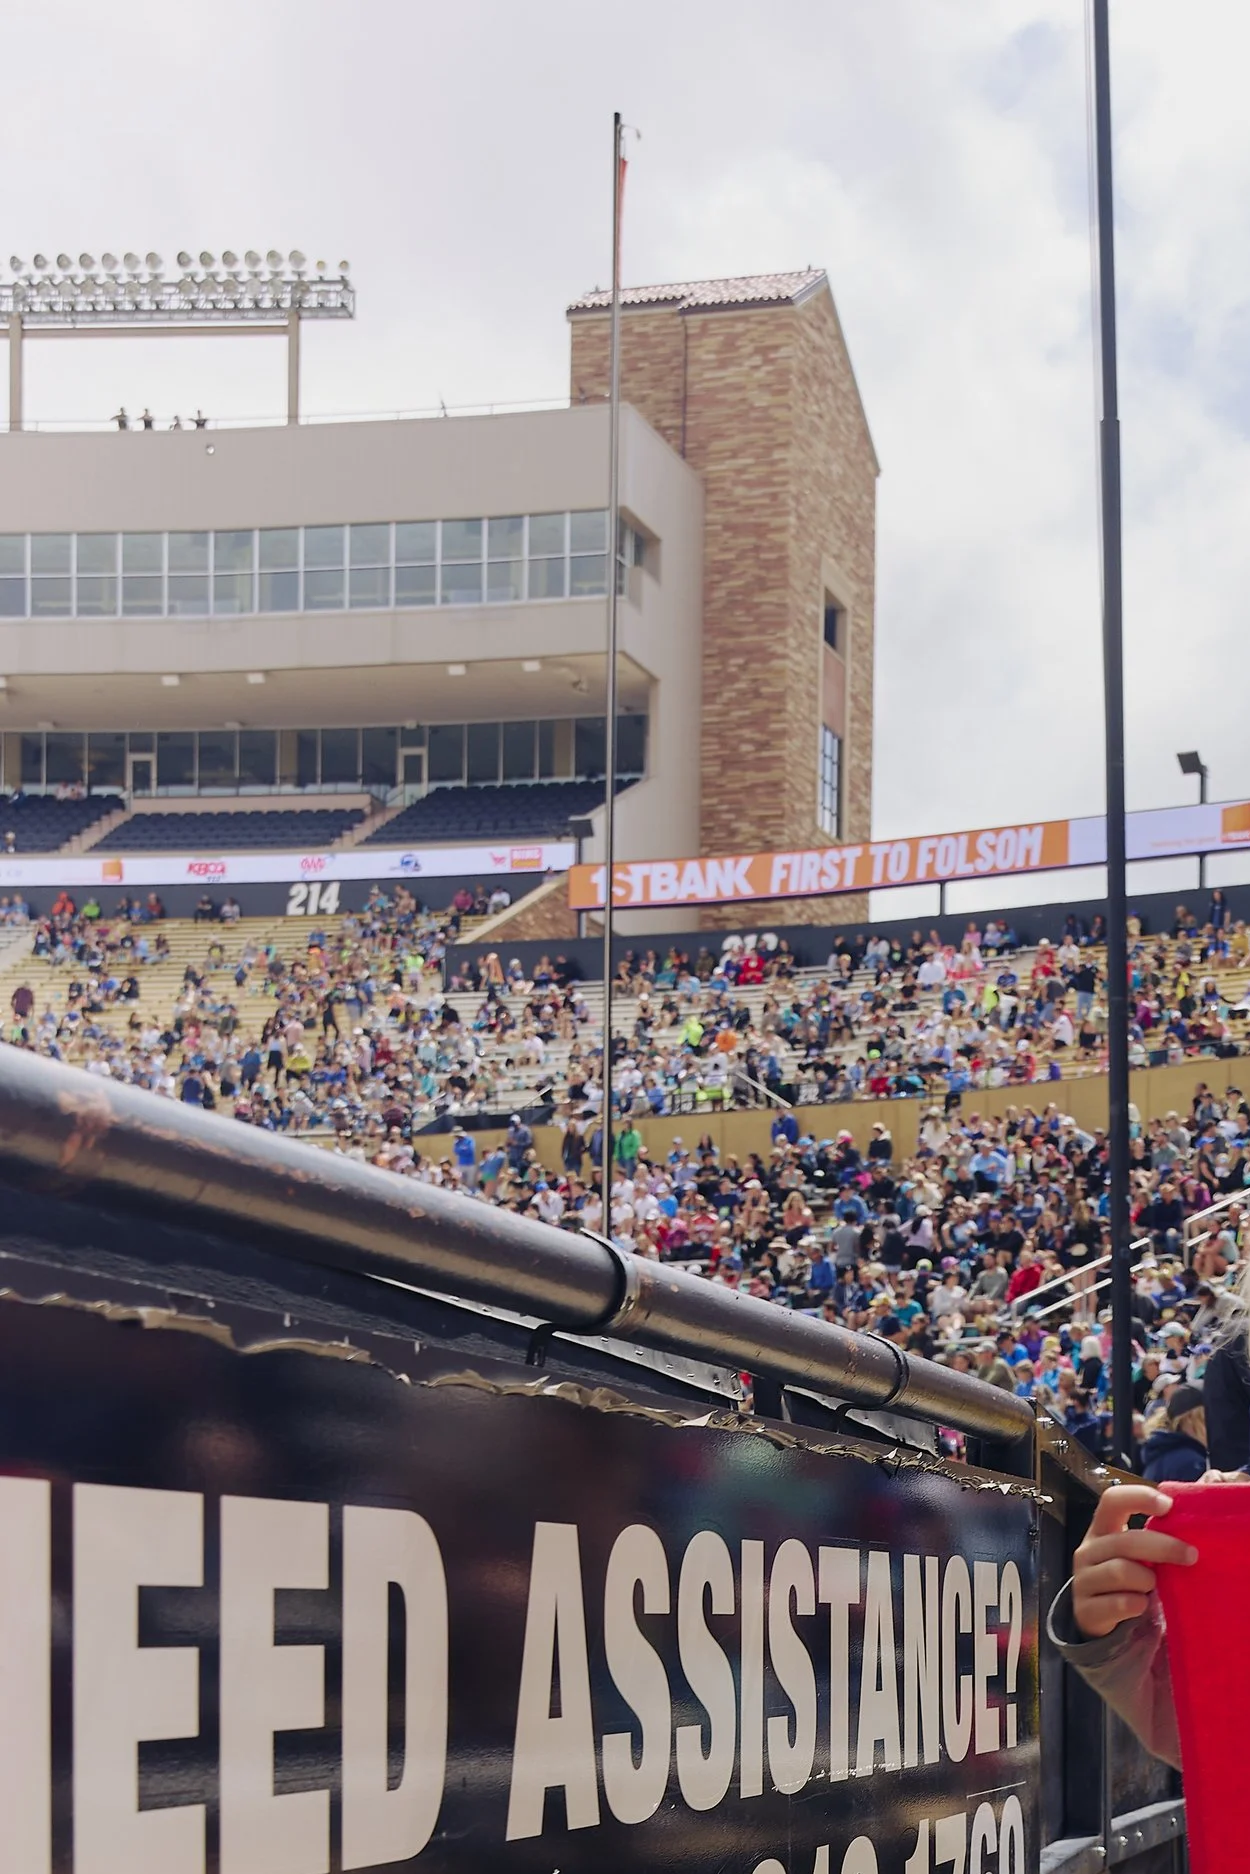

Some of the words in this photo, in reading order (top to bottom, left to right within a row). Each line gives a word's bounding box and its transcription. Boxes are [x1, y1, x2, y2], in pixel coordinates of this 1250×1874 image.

[286, 882, 341, 916] 214
[590, 857, 754, 904] 1STBANK
[769, 847, 863, 894] FIRST
[869, 842, 911, 884] TO
[915, 825, 1044, 879] FOLSOM
[506, 1521, 1023, 1841] ASSISTANCE?
